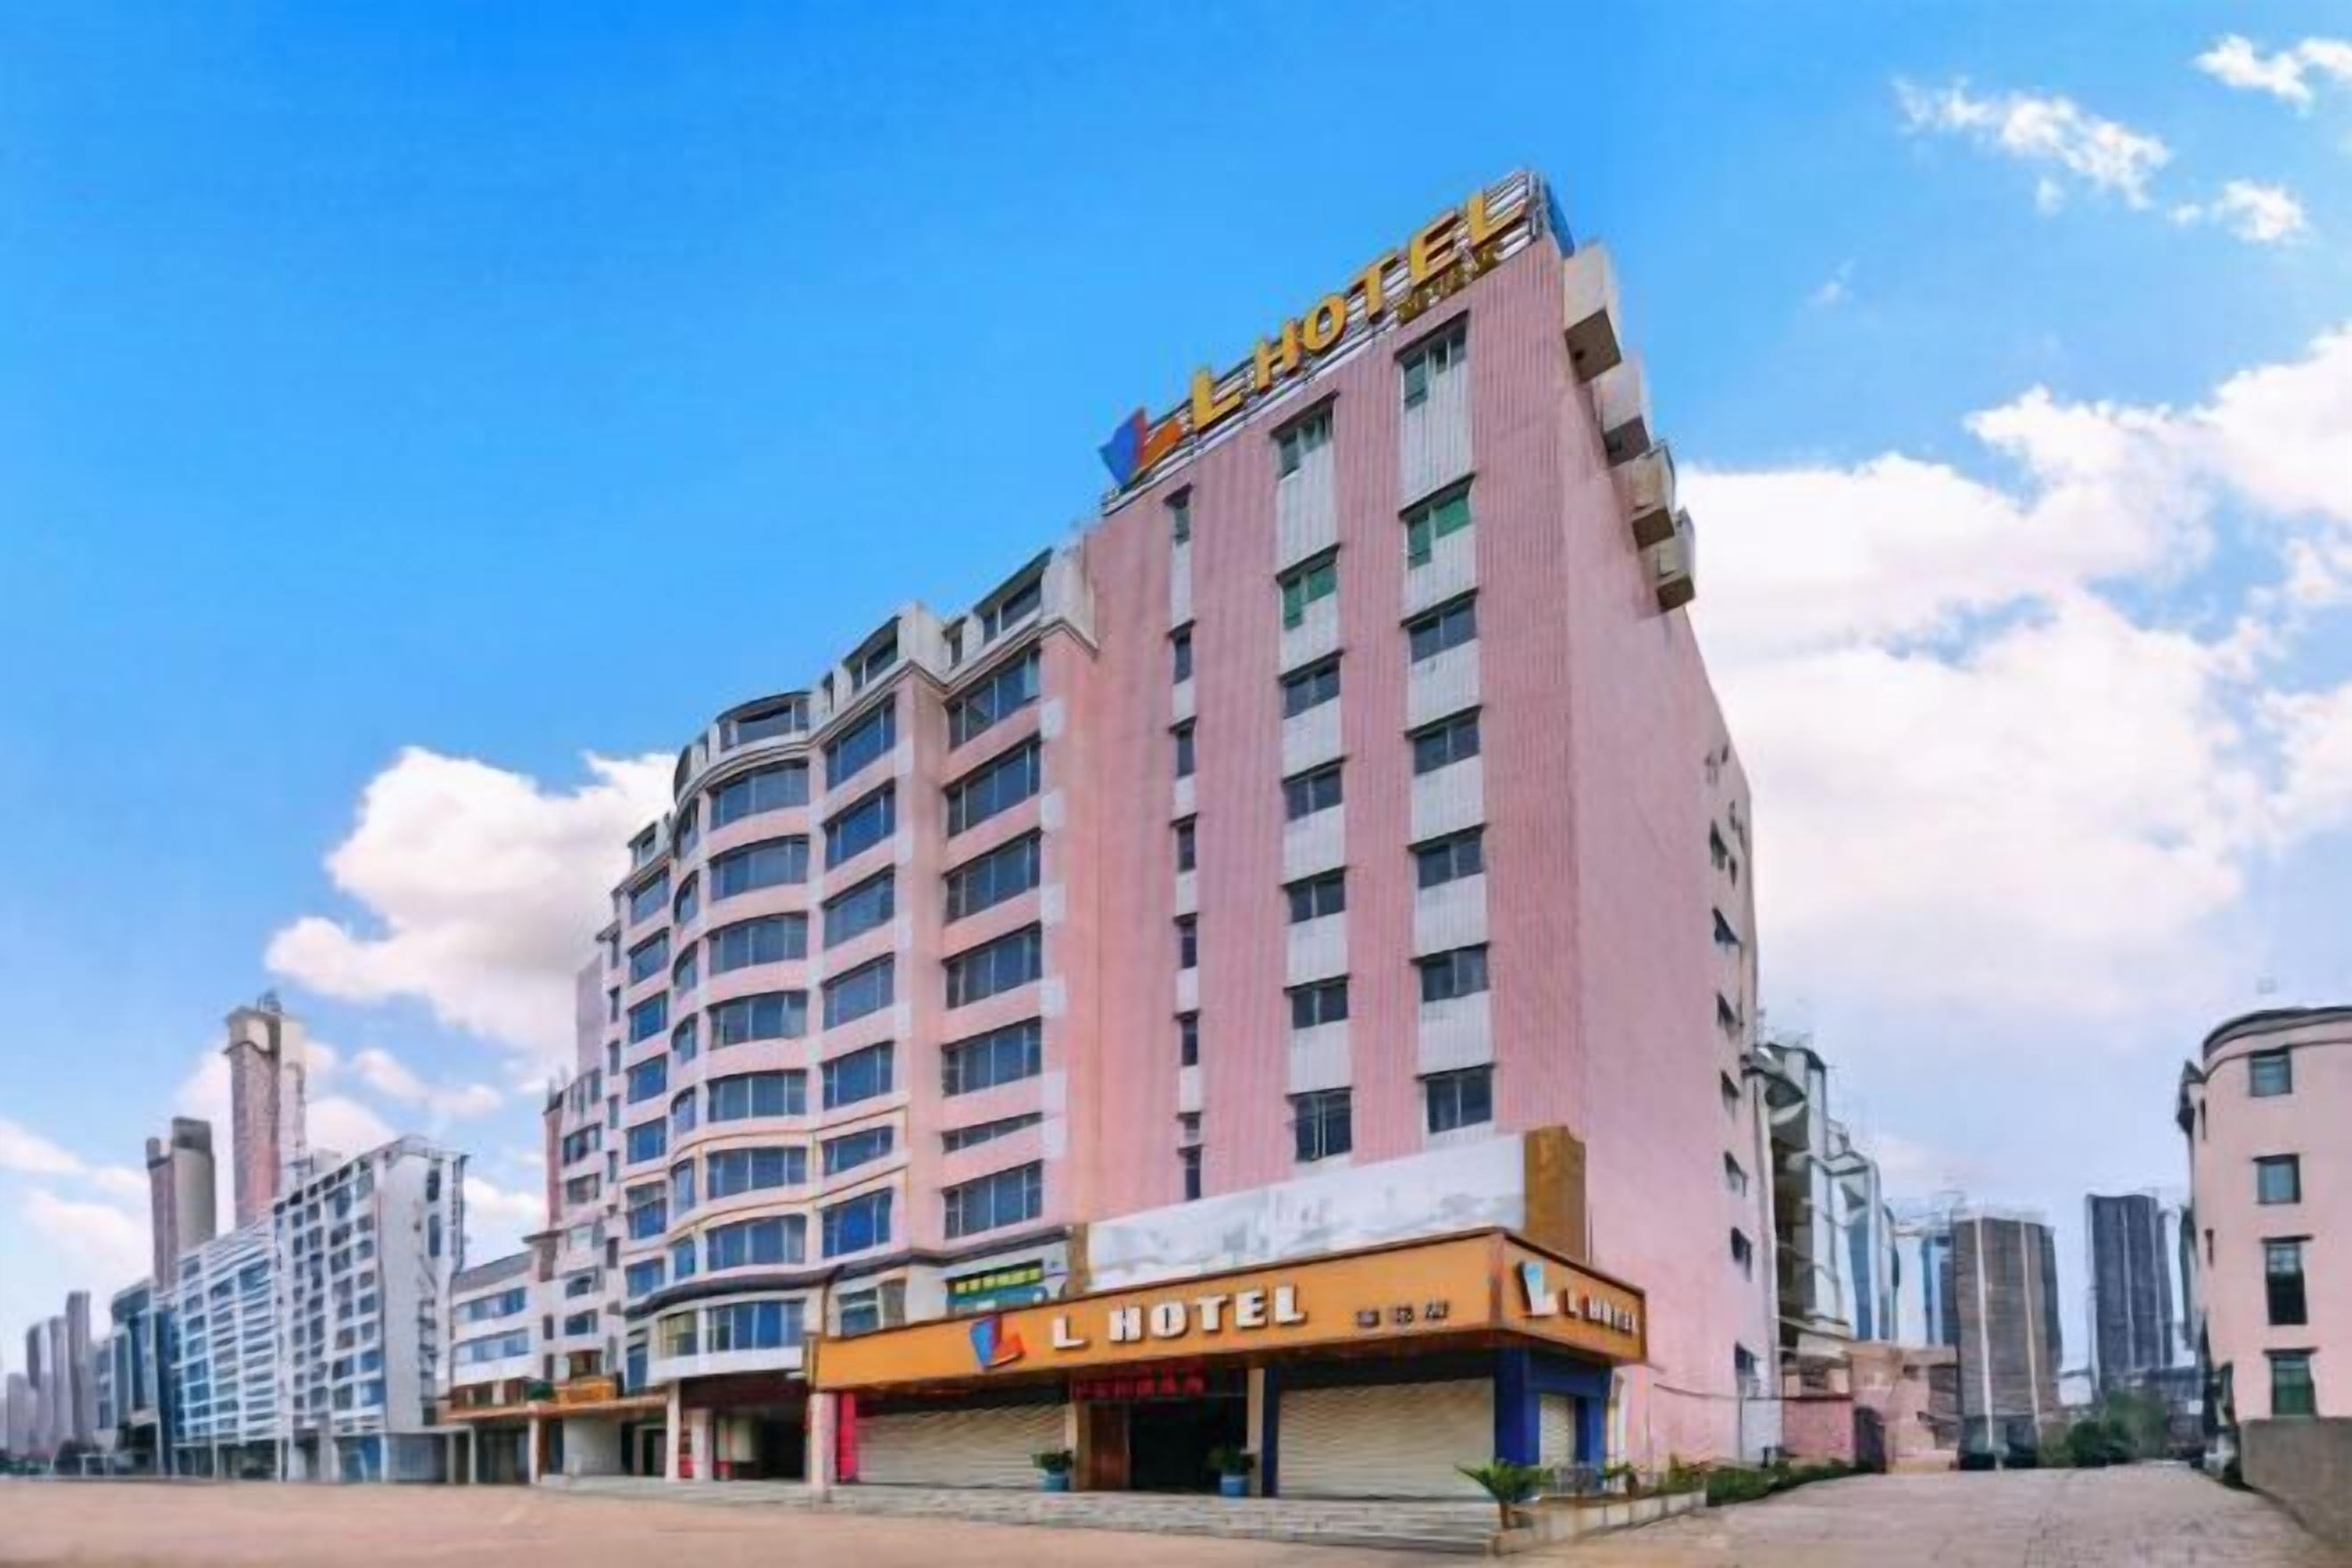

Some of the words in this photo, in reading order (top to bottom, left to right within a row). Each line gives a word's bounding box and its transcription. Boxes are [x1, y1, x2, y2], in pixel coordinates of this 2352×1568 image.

[1191, 366, 1245, 432] L
[1254, 190, 1528, 391] HOTEL
[1052, 1316, 1086, 1349] L
[1108, 1286, 1315, 1343] HOTEL
